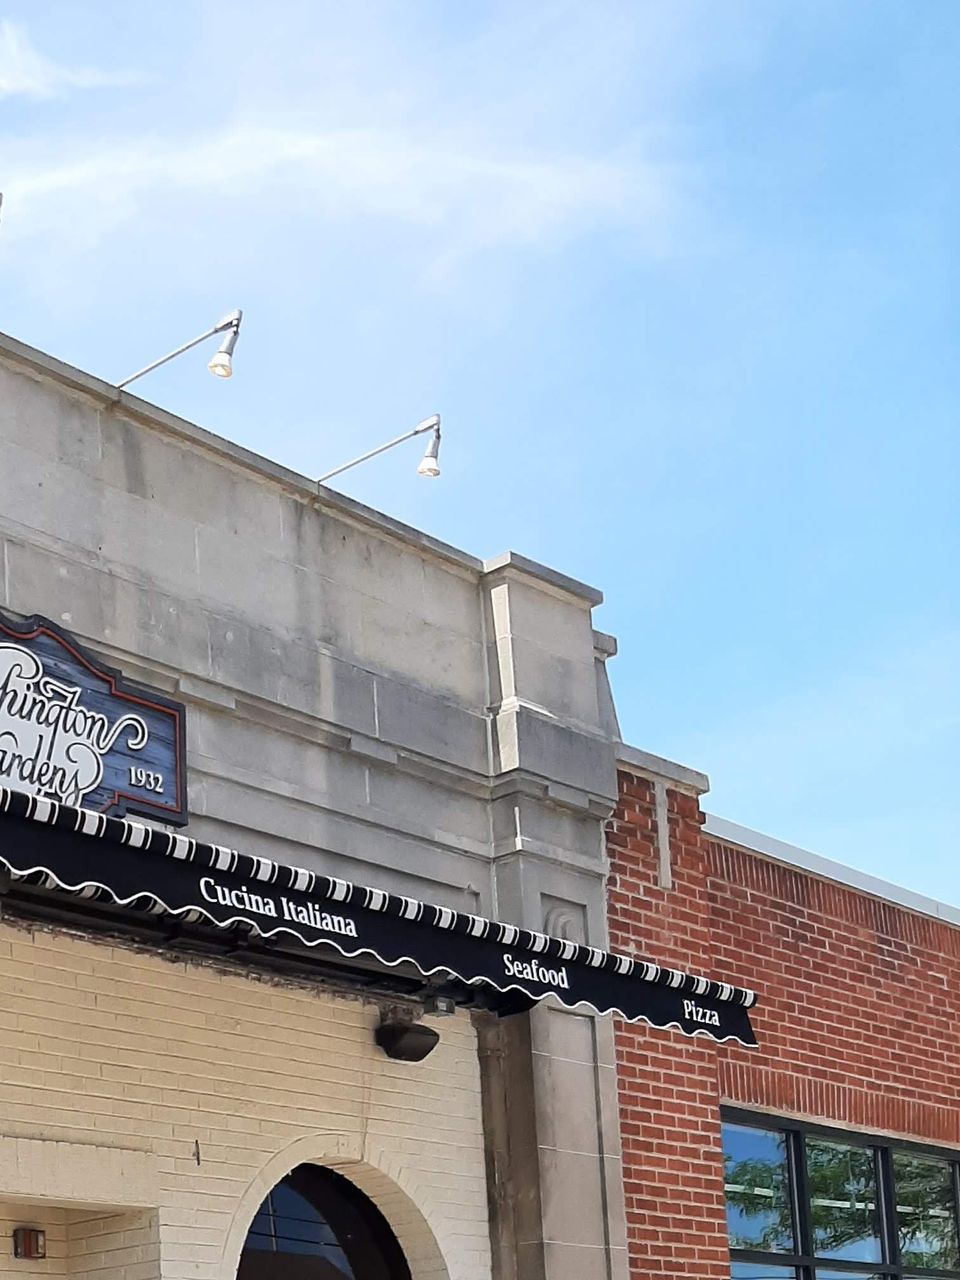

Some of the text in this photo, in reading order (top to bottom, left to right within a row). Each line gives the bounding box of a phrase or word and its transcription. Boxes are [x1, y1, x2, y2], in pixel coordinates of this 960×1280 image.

[130, 766, 164, 793] 1932
[200, 877, 359, 938] Cucina Italiana
[503, 953, 570, 989] Seafood
[683, 999, 721, 1027] Pizza
